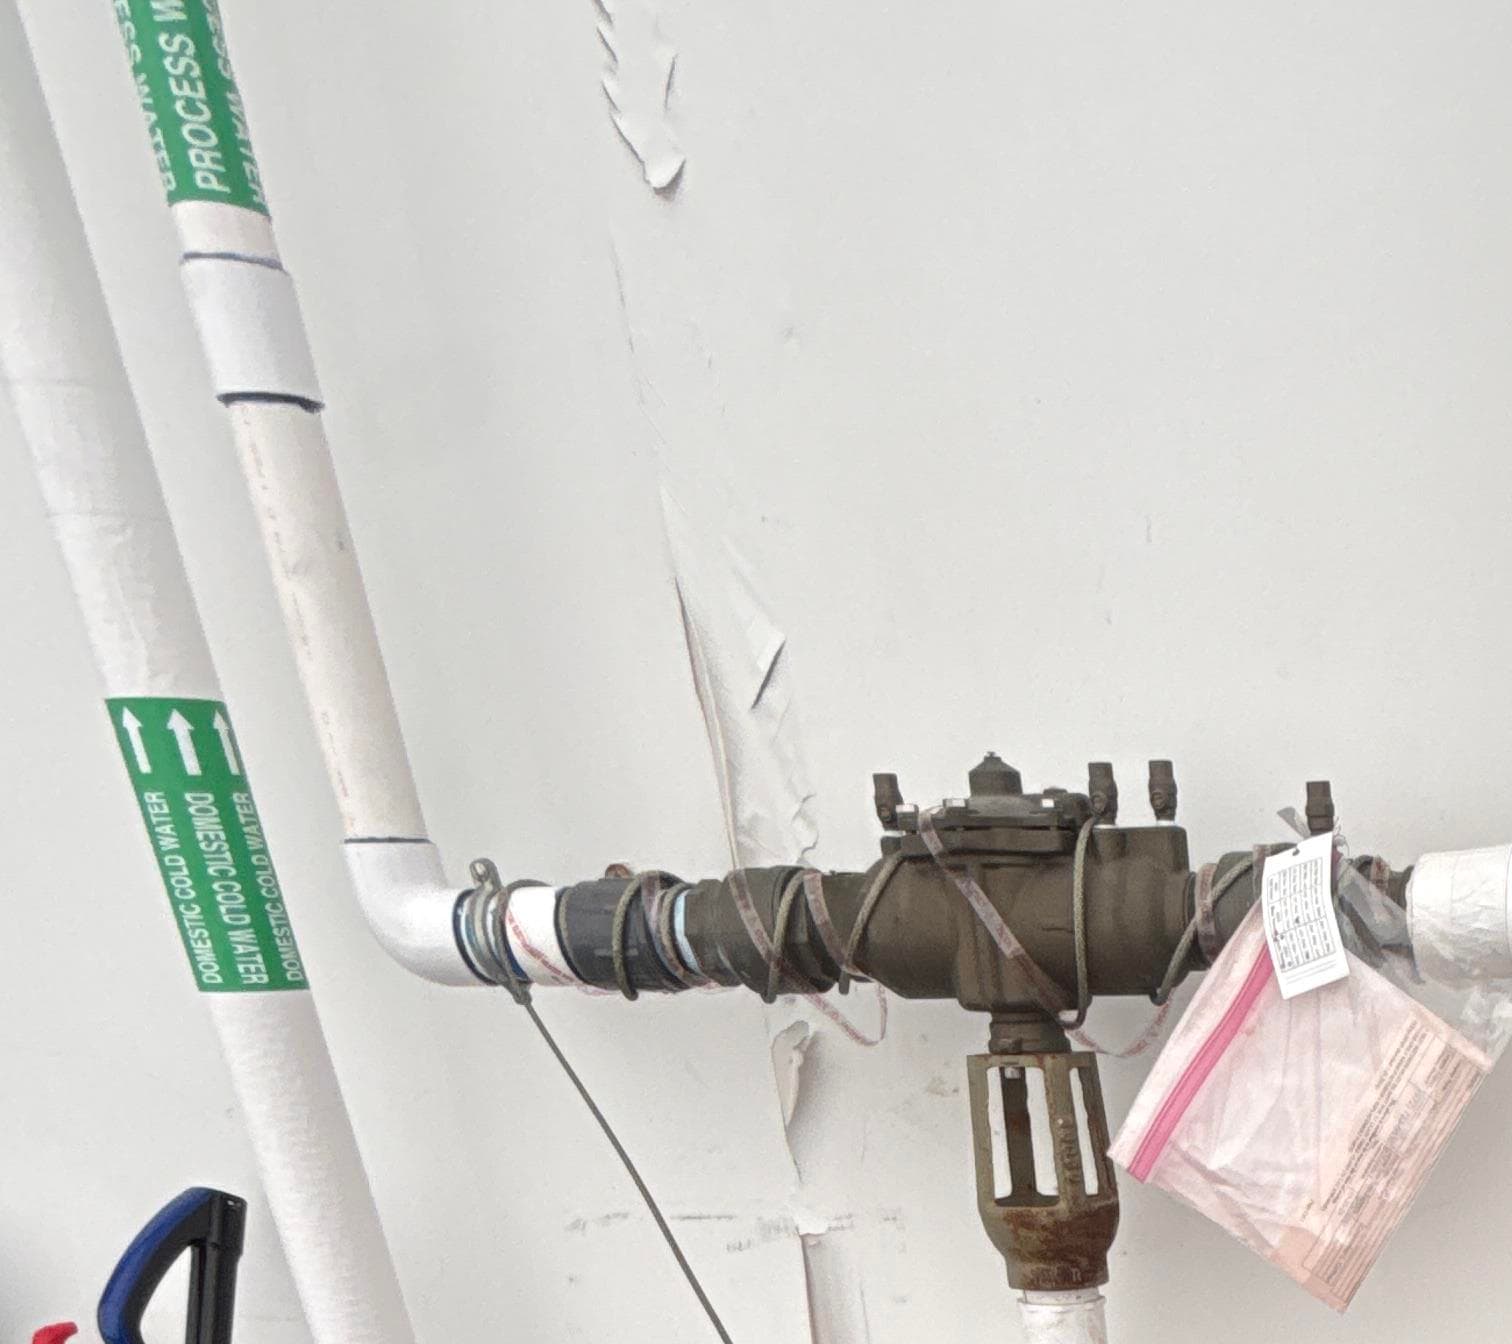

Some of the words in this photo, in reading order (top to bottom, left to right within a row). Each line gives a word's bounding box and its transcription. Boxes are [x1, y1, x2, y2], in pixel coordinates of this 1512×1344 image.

[158, 32, 231, 193] PROCESS
[144, 791, 181, 851] WATER
[184, 792, 237, 877] DOMESTIC
[232, 792, 264, 850] WATER
[164, 855, 196, 900] COLD
[212, 881, 251, 925] COLD
[251, 854, 278, 898] COLD
[179, 903, 223, 984] DOMESTIC
[228, 928, 269, 985] WATER
[265, 902, 304, 981] DOMESTIC
